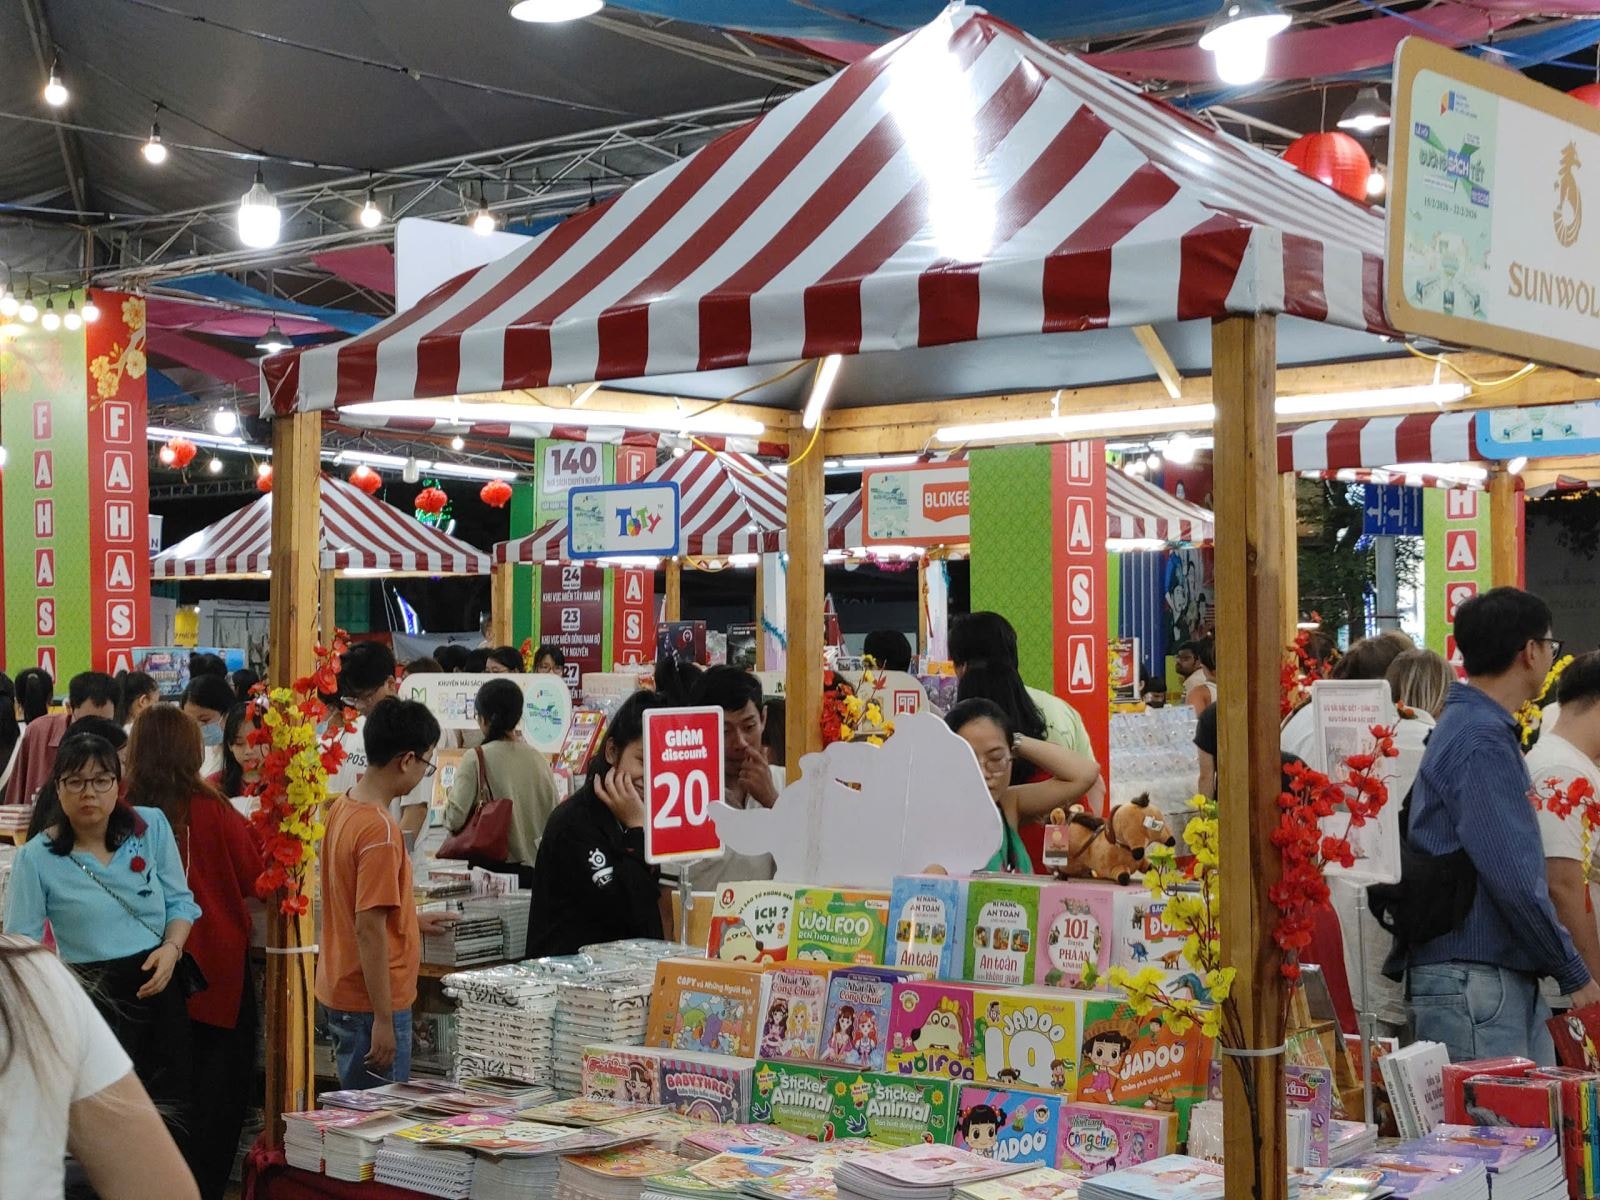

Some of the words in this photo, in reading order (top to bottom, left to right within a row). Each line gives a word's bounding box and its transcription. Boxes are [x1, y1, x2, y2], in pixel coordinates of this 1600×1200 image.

[551, 446, 596, 475] 140
[564, 569, 580, 582] 24
[563, 610, 579, 623] 23
[564, 666, 577, 678] 27
[665, 725, 703, 747] GIẢM
[661, 747, 707, 762] discount
[798, 911, 869, 937] WOLFOO
[1064, 918, 1088, 939] 101
[900, 950, 914, 966] An
[980, 955, 994, 969] An
[677, 976, 697, 987] CAPY
[667, 1075, 699, 1089] BABY
[699, 1076, 733, 1098] THREE
[782, 1075, 827, 1094] Sticker
[772, 1087, 834, 1113] Animal
[876, 1086, 923, 1103] Sticker
[867, 1098, 932, 1123] Animal
